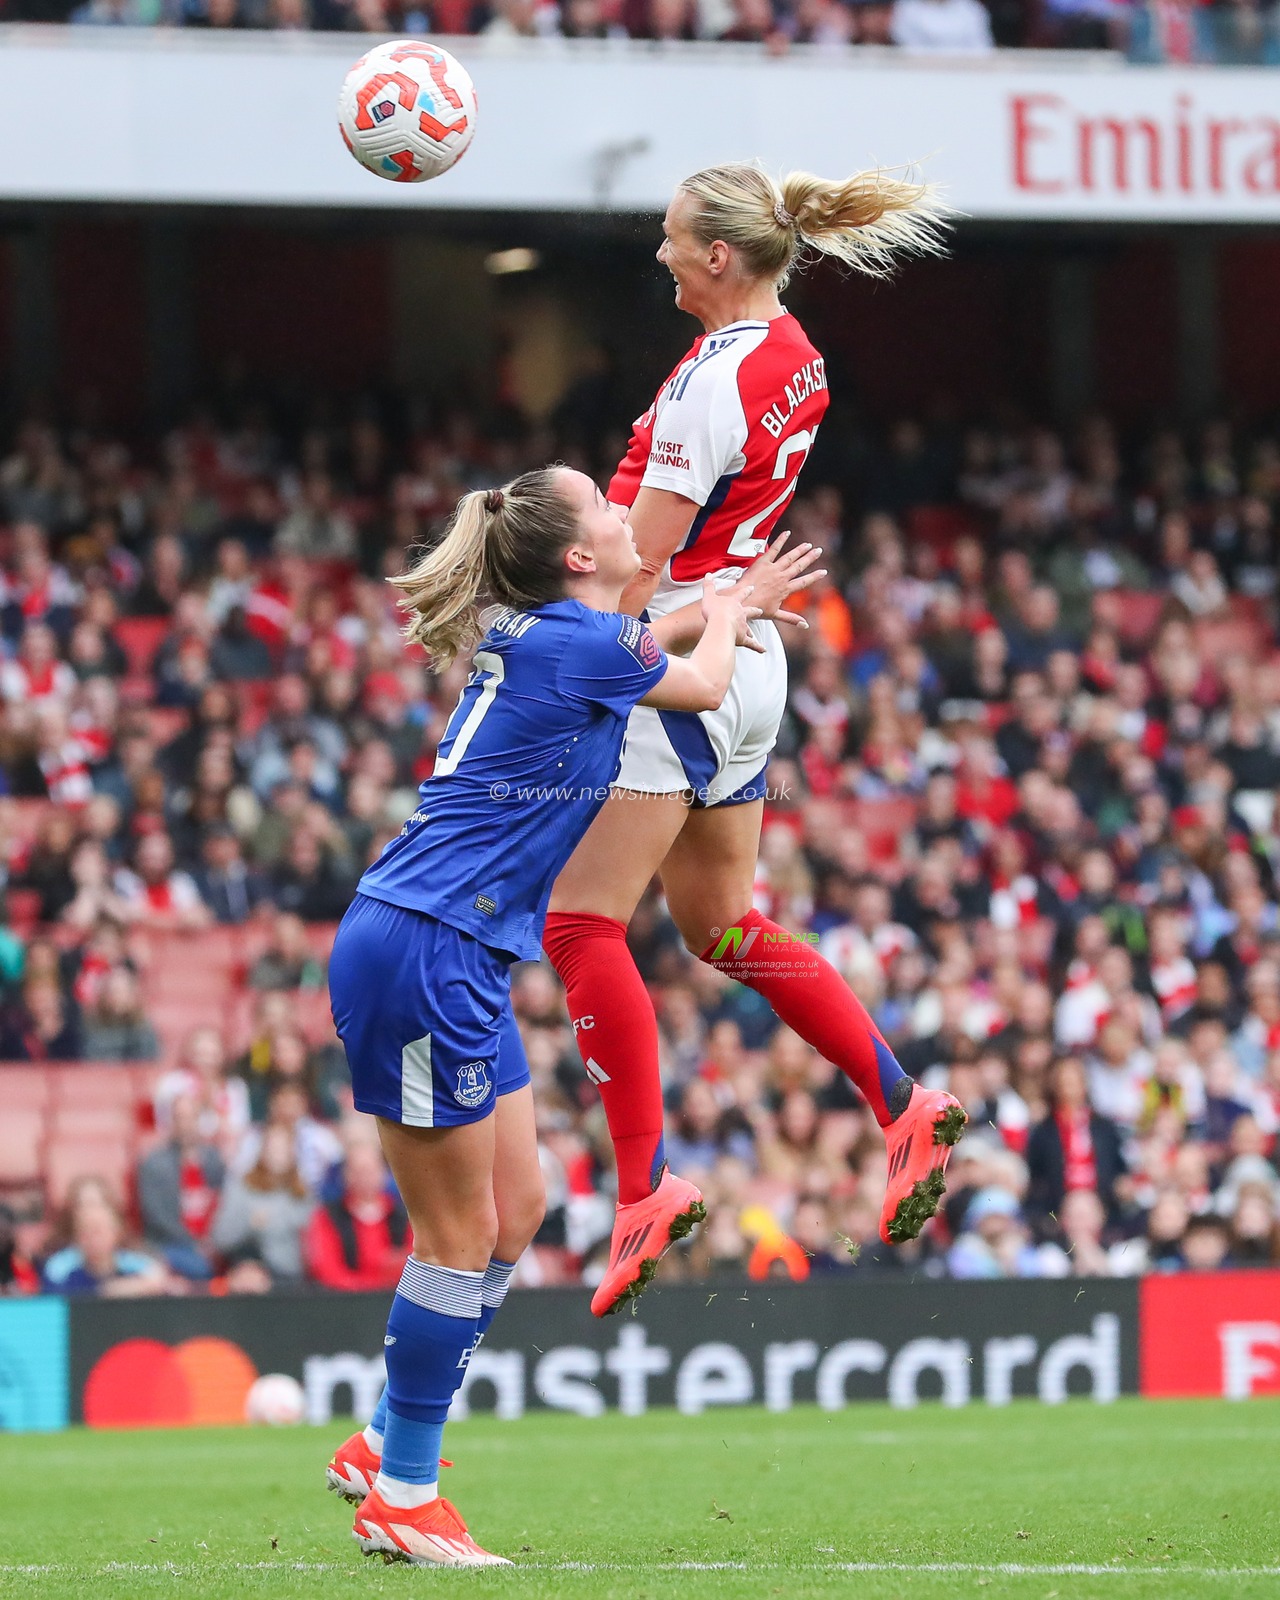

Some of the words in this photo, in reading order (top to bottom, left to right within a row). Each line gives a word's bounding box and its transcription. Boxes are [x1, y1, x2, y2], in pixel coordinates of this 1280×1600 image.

[1008, 92, 1280, 195] Emira
[760, 357, 828, 439] BLACKST
[656, 440, 684, 455] VISIT
